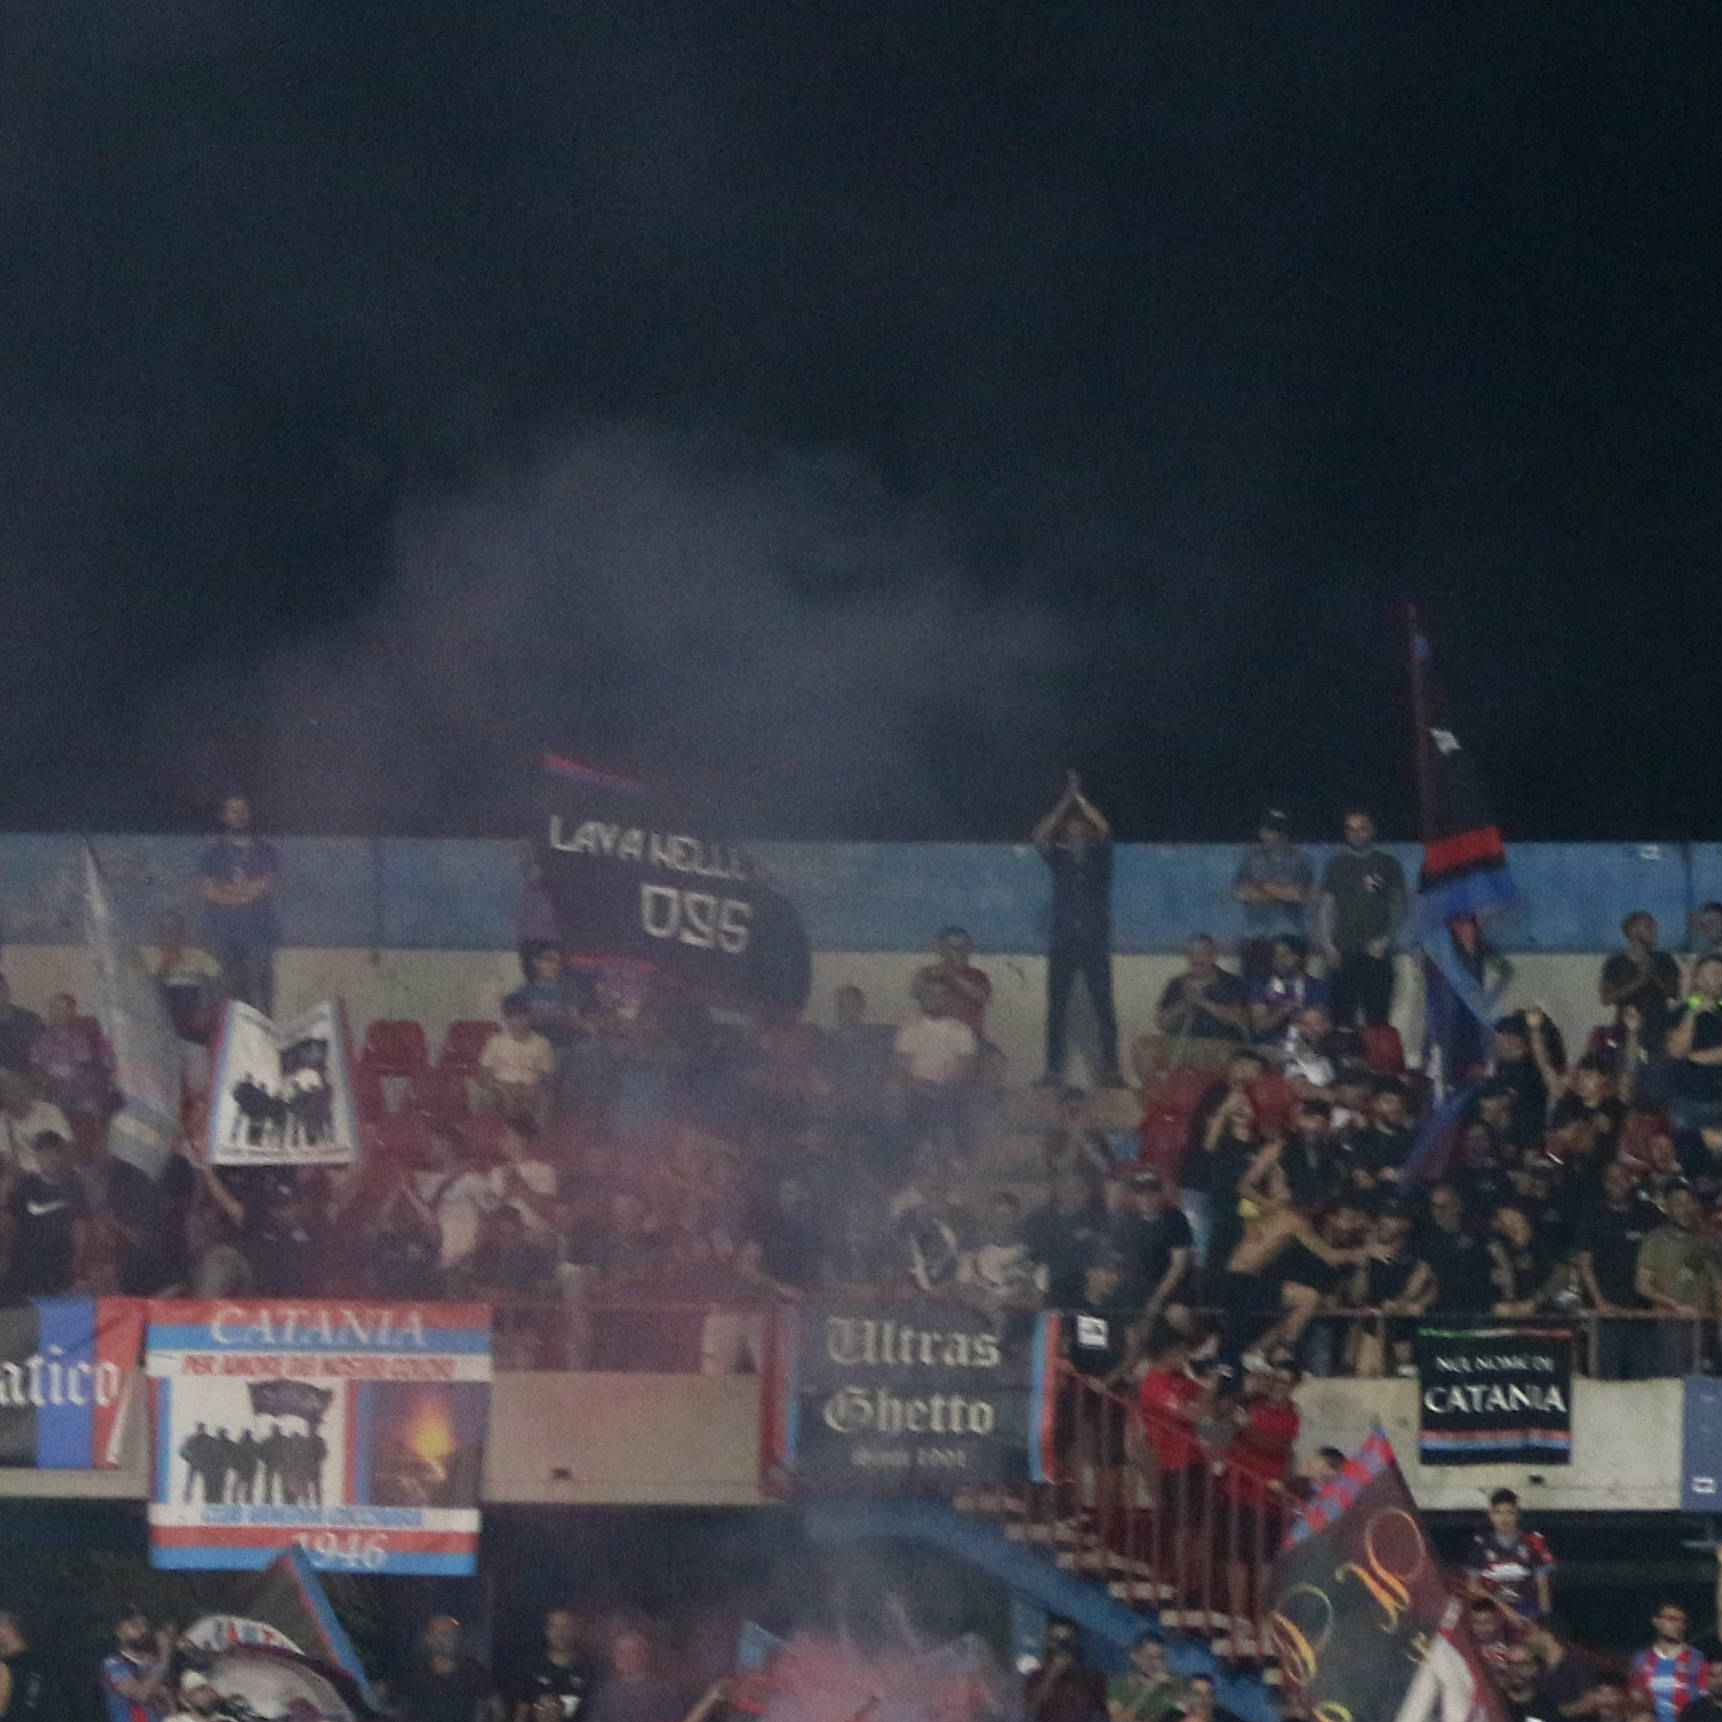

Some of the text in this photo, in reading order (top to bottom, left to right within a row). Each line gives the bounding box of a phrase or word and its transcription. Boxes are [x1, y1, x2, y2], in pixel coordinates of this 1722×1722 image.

[210, 1306, 429, 1346] CATANIA
[826, 1316, 1001, 1367] Ultras
[822, 1384, 995, 1435] Ghetto
[1423, 1382, 1567, 1414] CATANIA
